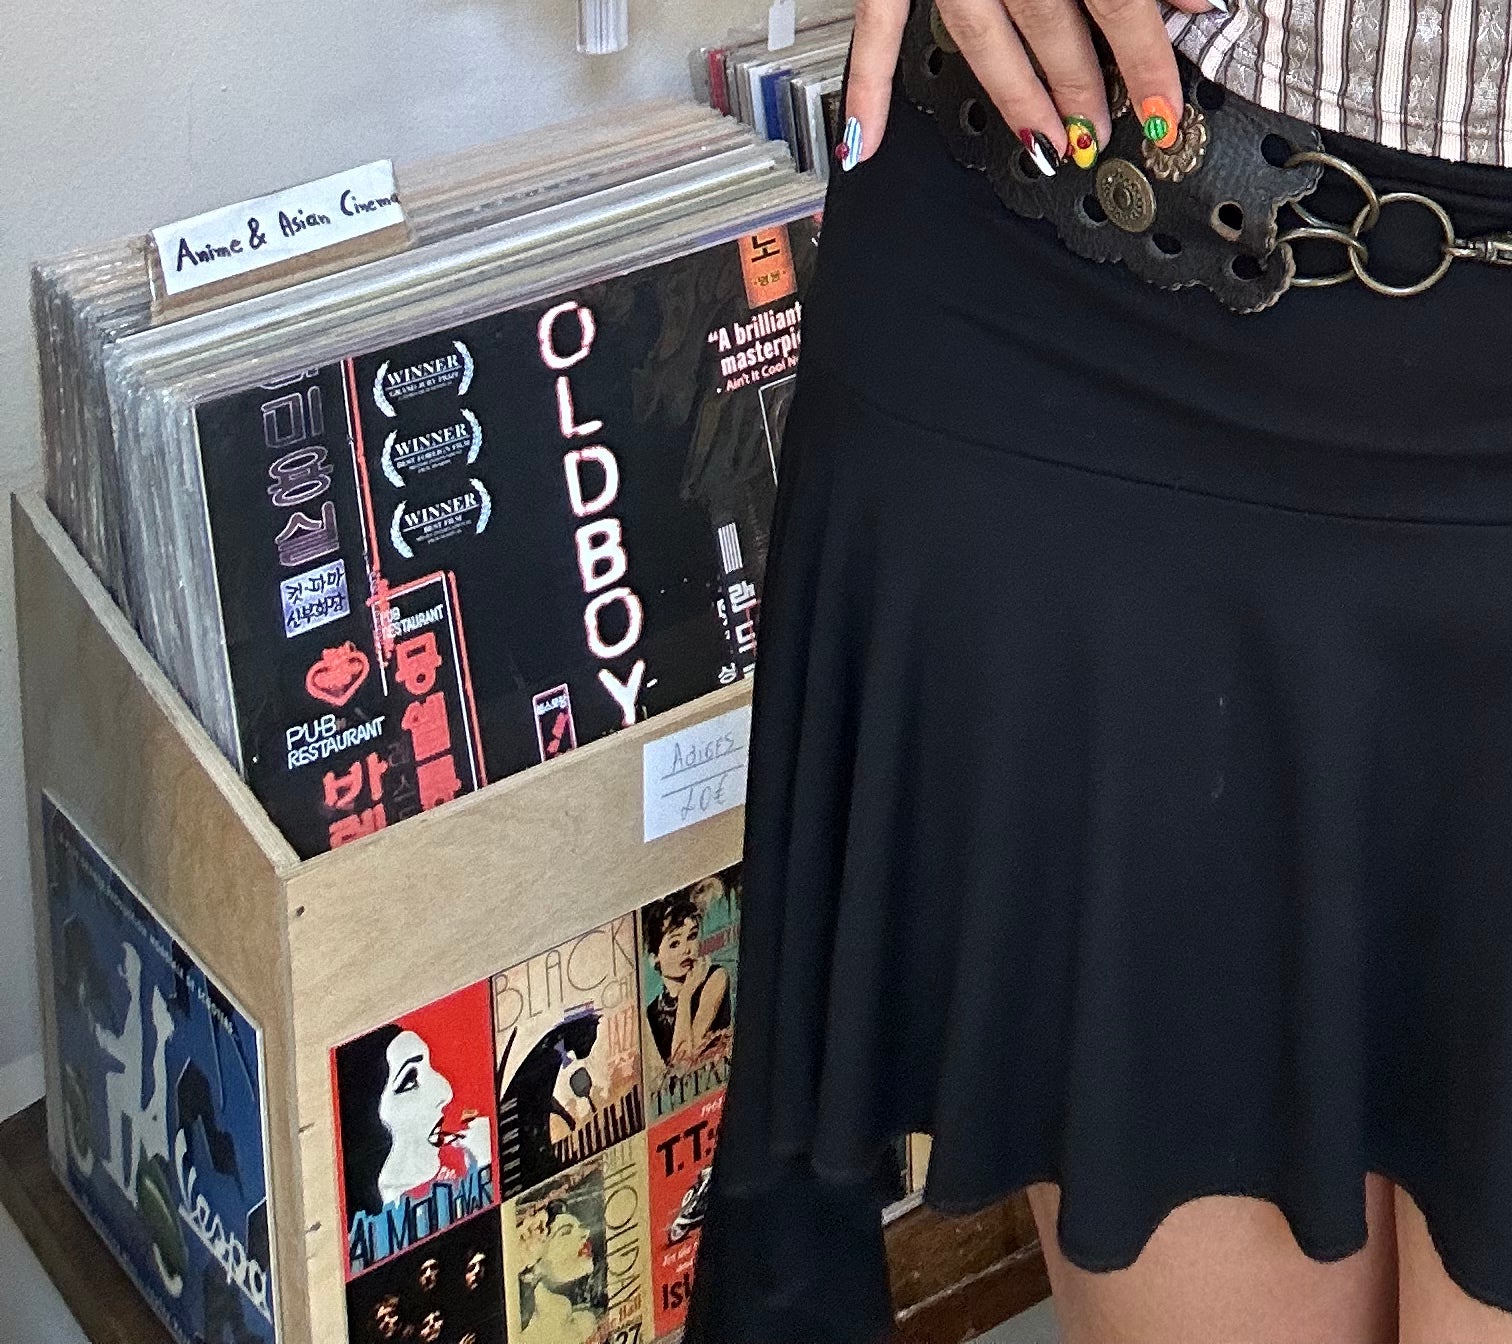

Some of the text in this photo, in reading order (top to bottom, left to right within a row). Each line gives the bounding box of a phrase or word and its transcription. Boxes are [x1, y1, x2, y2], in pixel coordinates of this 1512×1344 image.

[176, 237, 244, 272] Anime
[247, 216, 268, 250] &
[278, 209, 332, 238] Asian
[733, 300, 802, 346] brilliant
[386, 353, 459, 388] WINNER
[394, 422, 468, 457] WINNER
[403, 491, 478, 528] WINNER
[536, 299, 646, 728] OLDBOY
[286, 713, 337, 752] PUB
[287, 715, 387, 770] RESTAURANT
[492, 917, 636, 1034] BLACK
